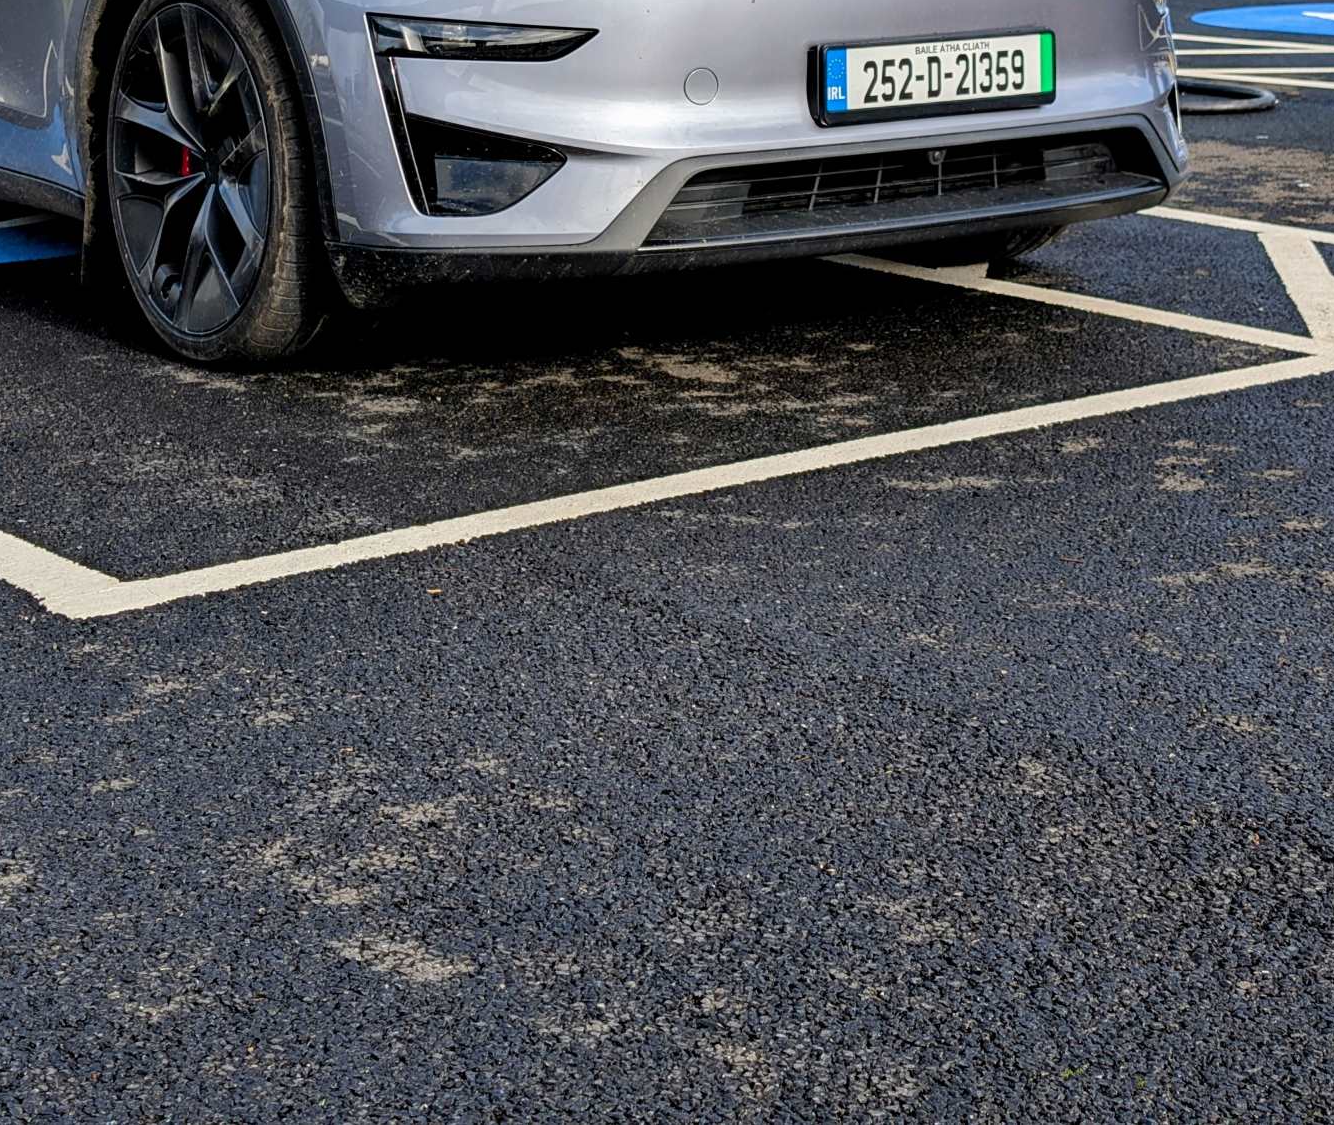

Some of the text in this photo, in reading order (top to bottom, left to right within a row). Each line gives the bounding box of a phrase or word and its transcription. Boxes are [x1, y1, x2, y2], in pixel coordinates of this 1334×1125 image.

[915, 42, 990, 55] BAILE ÁTHA CLIATH
[864, 49, 1024, 104] 252-D-21359
[827, 86, 845, 101] IRL
